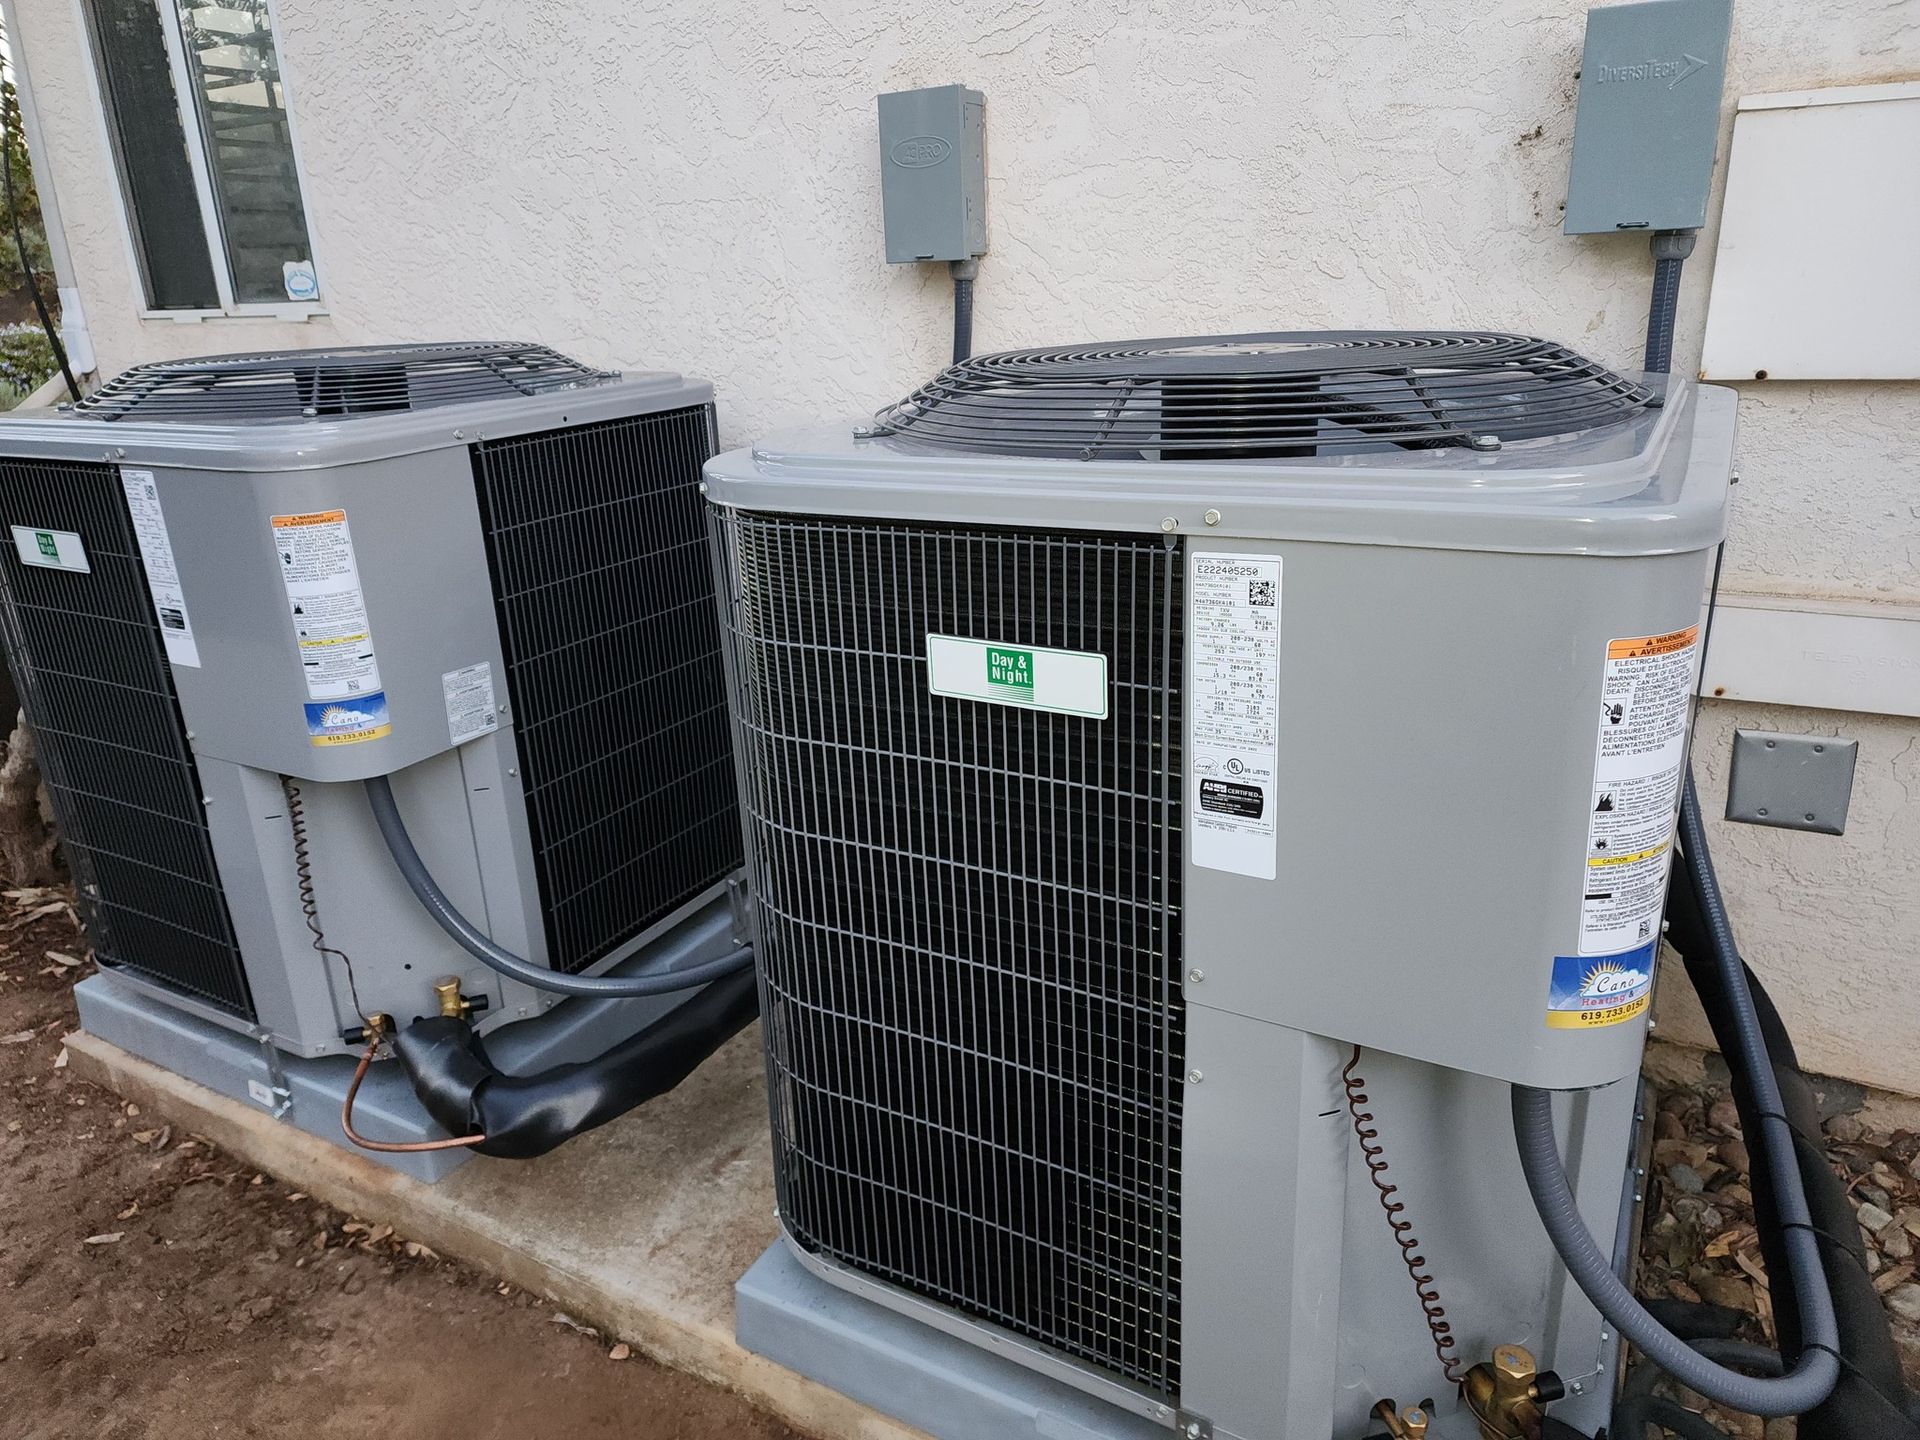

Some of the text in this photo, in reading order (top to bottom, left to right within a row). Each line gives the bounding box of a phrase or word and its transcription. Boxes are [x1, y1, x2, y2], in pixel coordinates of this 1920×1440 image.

[1197, 565, 1258, 576] E222405250
[1656, 632, 1686, 644] WARNING
[1640, 638, 1694, 656] AVERTISSEMENT
[992, 652, 1026, 670] Day &
[1614, 657, 1660, 667] ELECTRICAL
[1662, 652, 1680, 661] SHOCK
[1618, 666, 1646, 674] RISQUE
[1634, 681, 1670, 692] DISCONNECT
[1634, 690, 1662, 699] ELECTRIC
[1632, 697, 1657, 706] BEFORE
[332, 715, 359, 724] Cano
[1628, 717, 1658, 728] POUVANT
[1604, 726, 1646, 736] BLESSURES
[1648, 724, 1657, 732] OU
[1602, 739, 1656, 750] ALIMENTATIONS
[1601, 750, 1625, 758] AVANT
[1228, 788, 1258, 798] CERTIFIED
[1597, 976, 1634, 992] Cano
[1582, 994, 1626, 1006] Heating
[1581, 998, 1644, 1020] 619.733.0152
